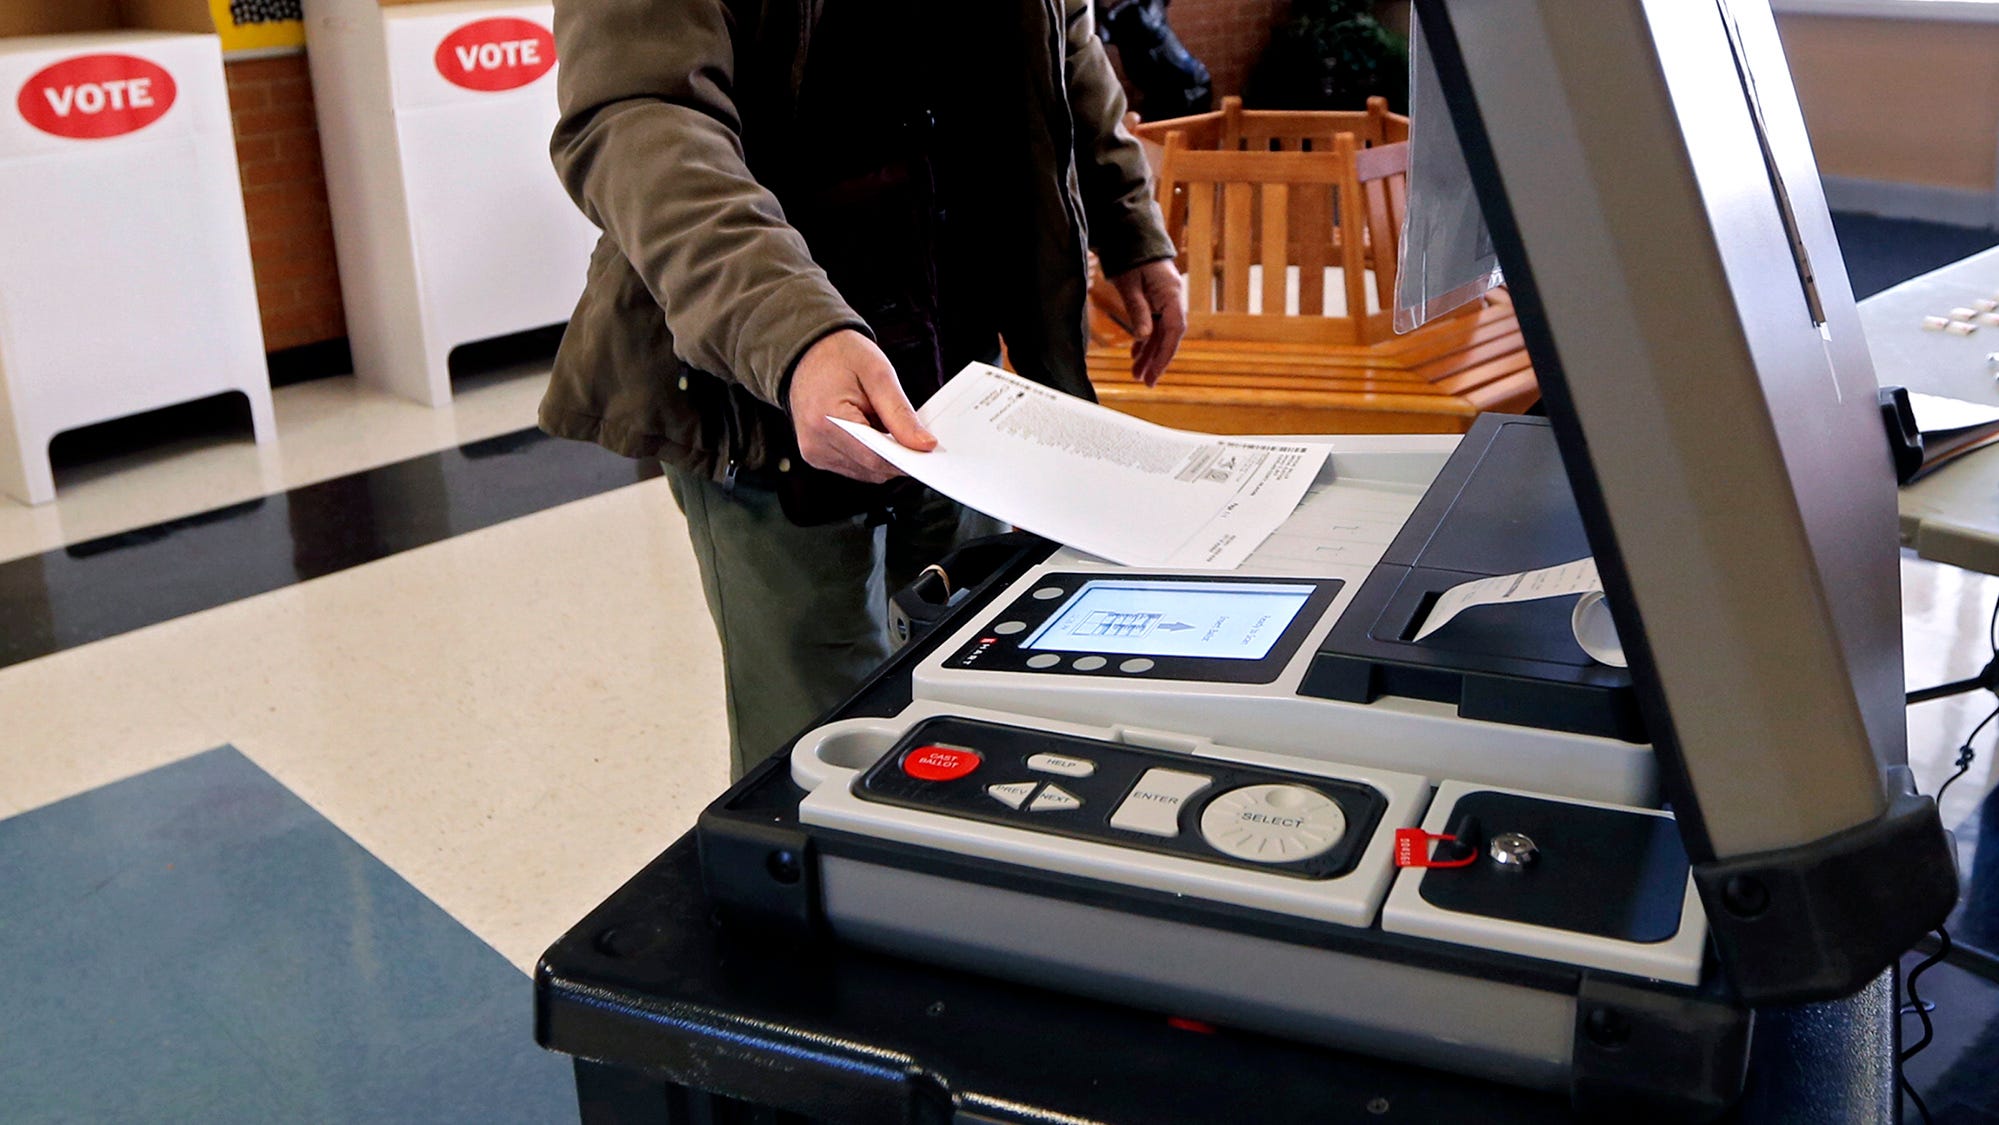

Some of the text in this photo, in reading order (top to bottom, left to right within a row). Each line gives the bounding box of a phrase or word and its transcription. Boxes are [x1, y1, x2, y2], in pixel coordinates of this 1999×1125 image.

[455, 38, 541, 72] VOTE
[43, 78, 154, 117] VOTE
[963, 643, 991, 665] HART
[918, 757, 960, 769] BALLOT
[929, 752, 958, 762] CAST
[1046, 758, 1077, 769] HELP
[996, 784, 1029, 795] PREV
[1039, 792, 1071, 804] NEXT
[1133, 791, 1180, 805] ENTER
[1241, 812, 1305, 829] SELECT
